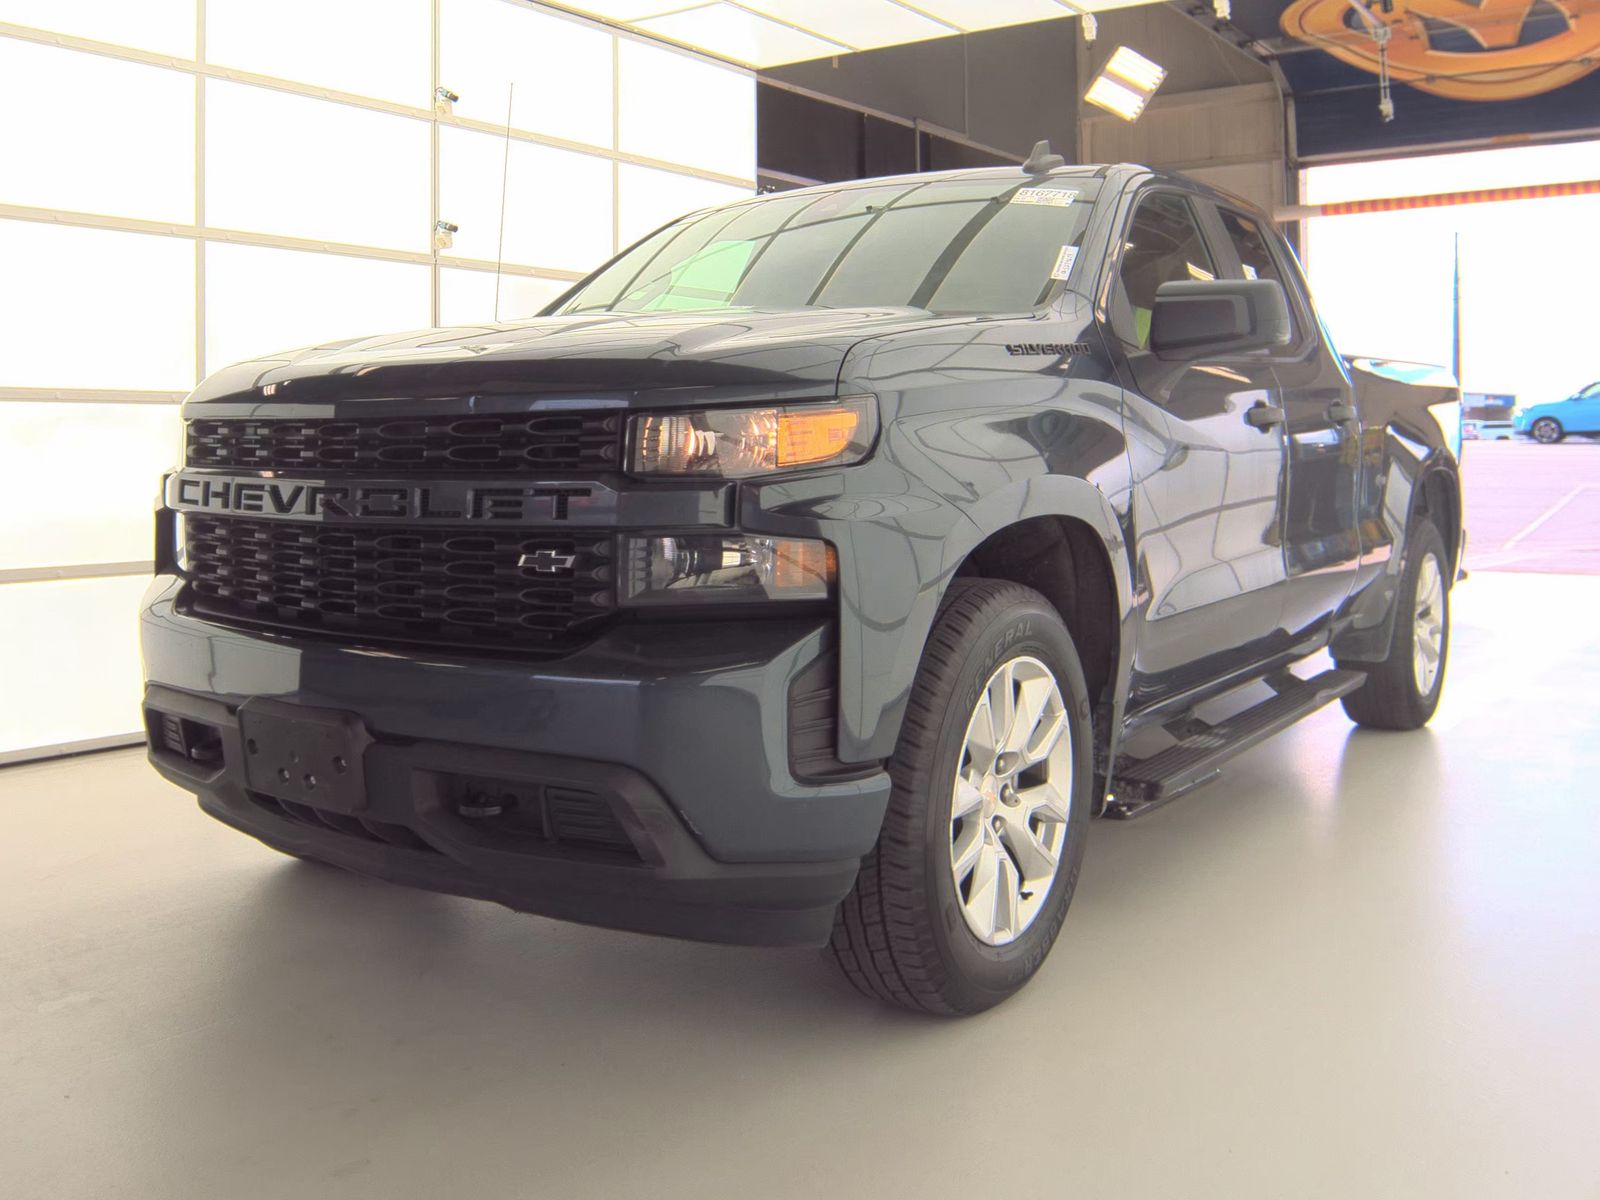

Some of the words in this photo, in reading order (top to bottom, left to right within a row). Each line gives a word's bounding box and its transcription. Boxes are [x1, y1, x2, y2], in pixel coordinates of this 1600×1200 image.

[1005, 343, 1091, 356] SILVERADO
[178, 478, 592, 521] CHEVROLET
[965, 619, 1033, 712] GENERAL
